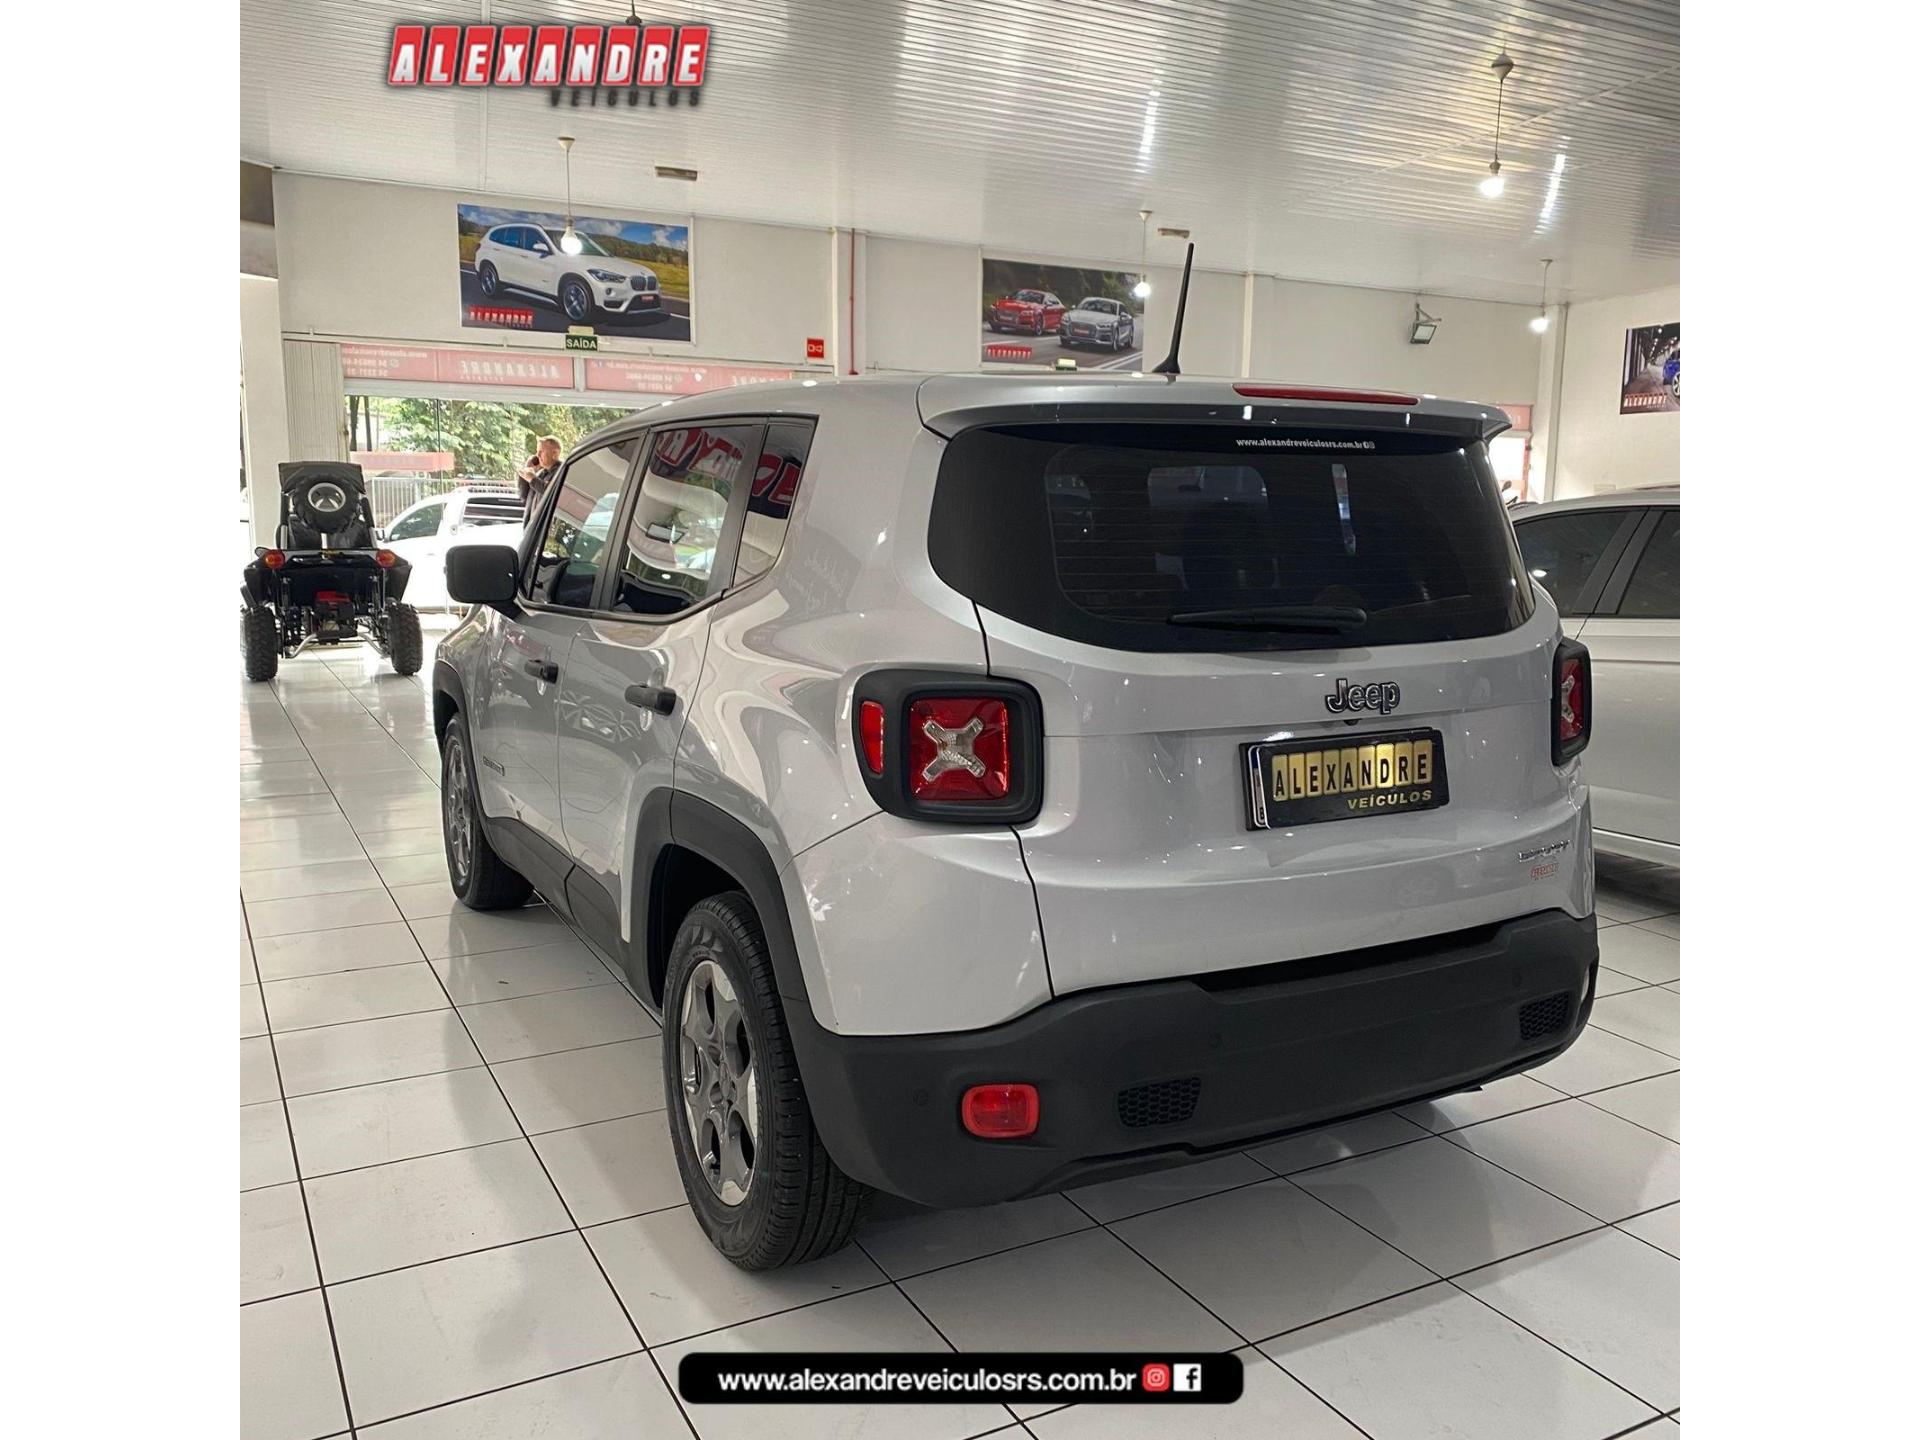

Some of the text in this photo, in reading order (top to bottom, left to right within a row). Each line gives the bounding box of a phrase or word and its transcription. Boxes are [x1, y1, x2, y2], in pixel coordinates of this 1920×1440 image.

[566, 337, 598, 349] SAÍDA
[1236, 438, 1362, 449] www.alexandreveiculosrs.com.br
[1325, 678, 1400, 715] Jeep
[1275, 754, 1427, 798] ALEXANDRE
[1347, 790, 1432, 809] VEÍCULOS
